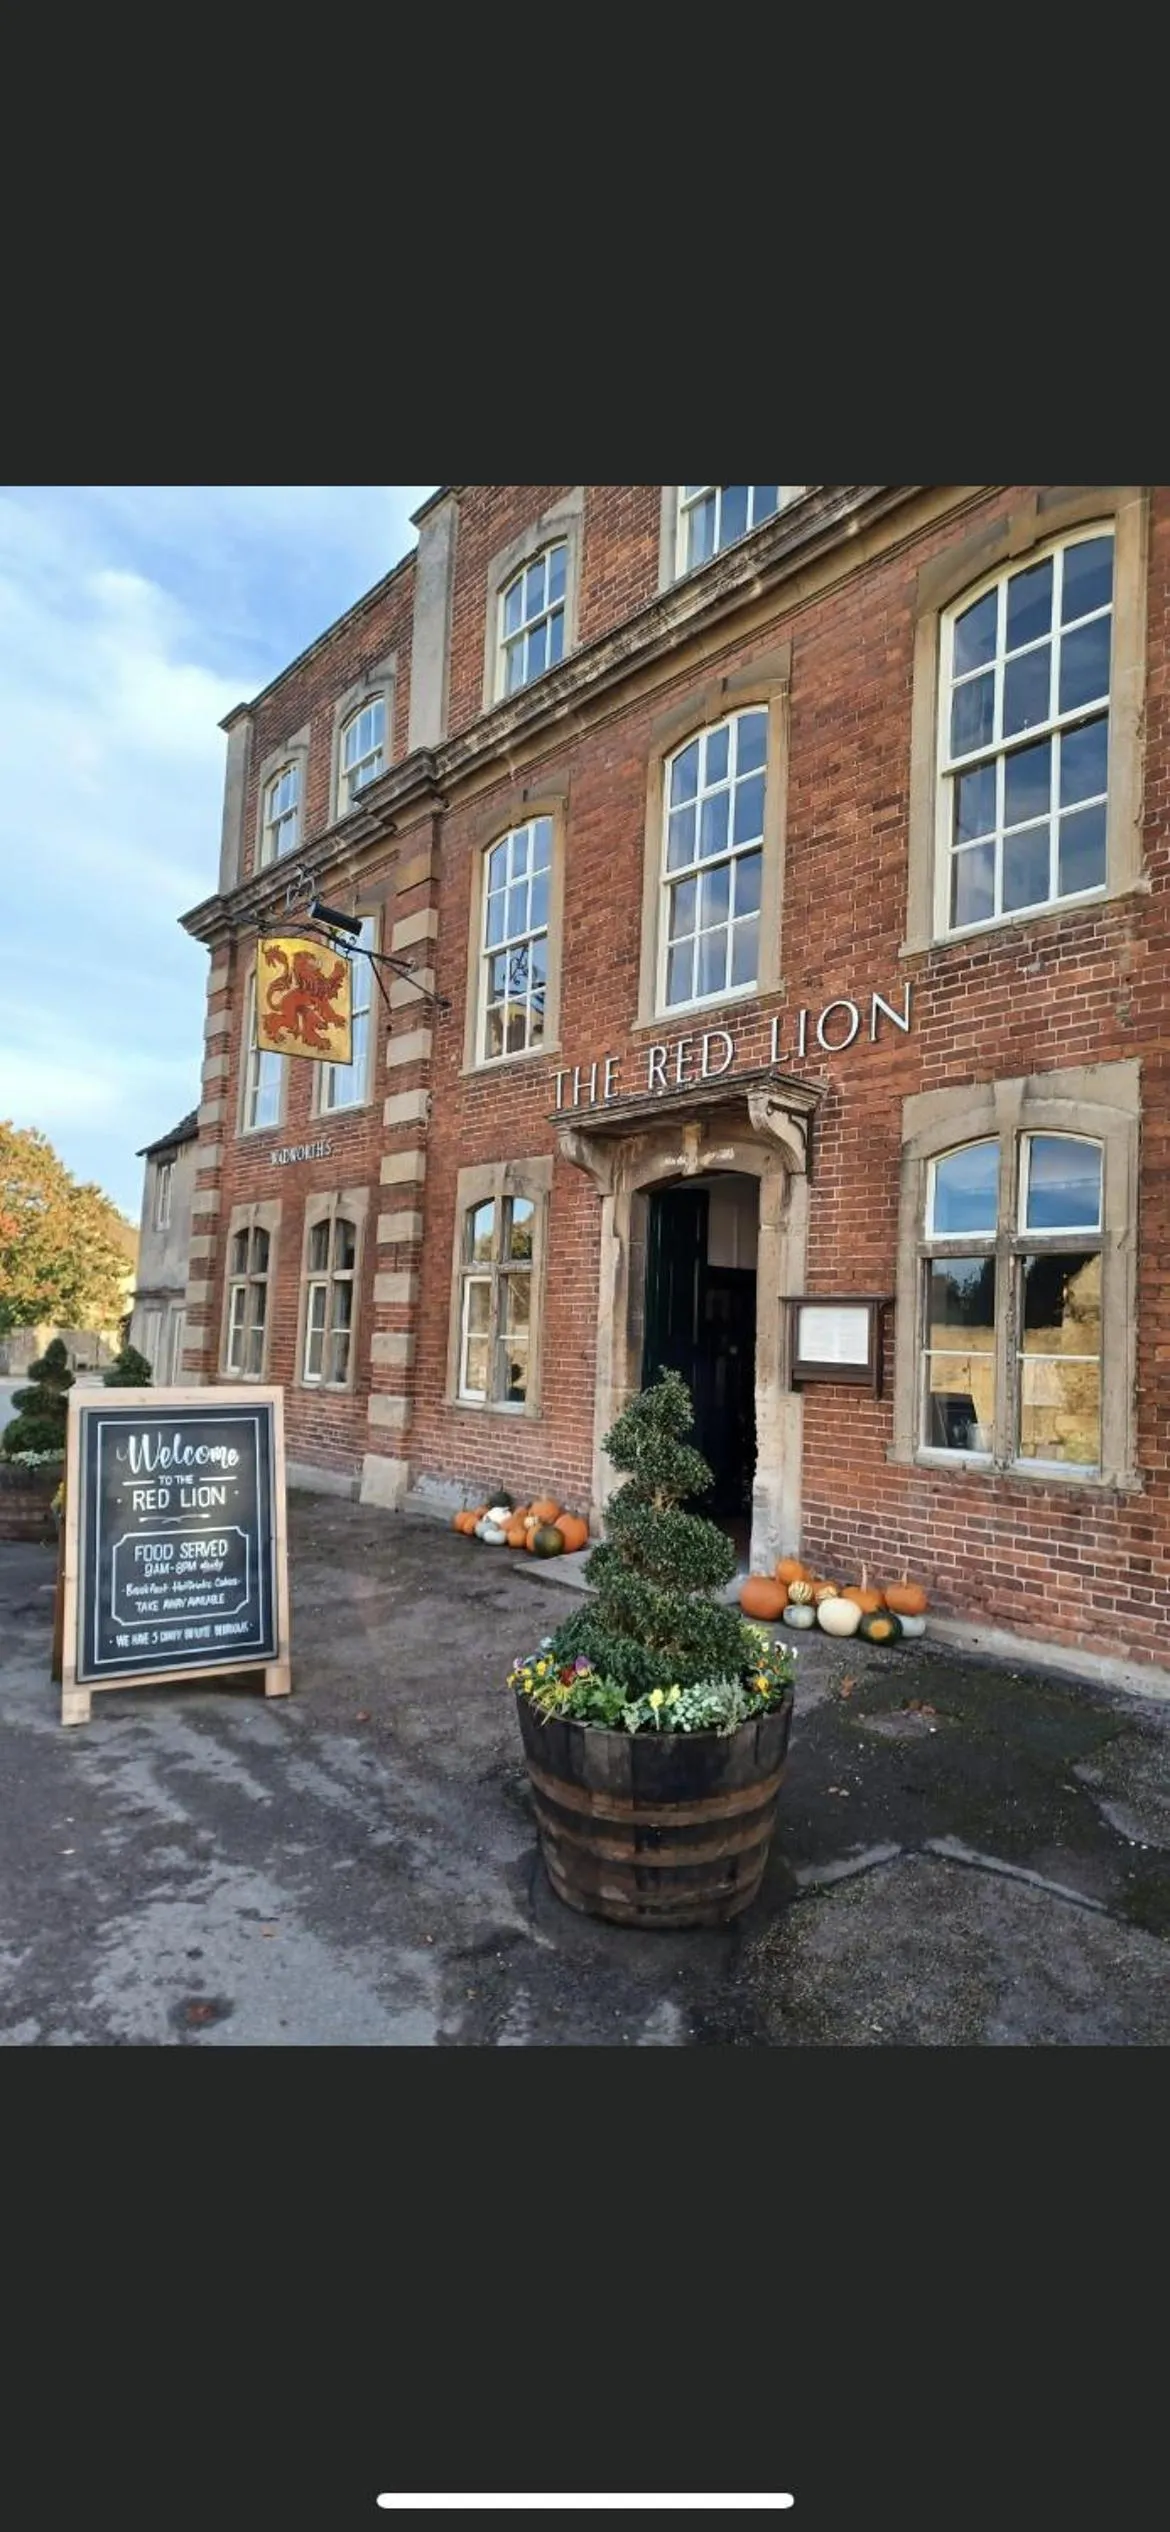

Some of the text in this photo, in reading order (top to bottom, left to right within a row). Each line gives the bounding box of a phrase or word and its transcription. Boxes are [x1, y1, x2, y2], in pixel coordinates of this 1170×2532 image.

[551, 982, 912, 1110] THE RED LION
[116, 1431, 239, 1474] Welcome
[158, 1474, 194, 1486] TO THE
[132, 1486, 226, 1511] RED LION
[134, 1539, 228, 1562] FOOD SERVED
[134, 1600, 159, 1613] TAKE
